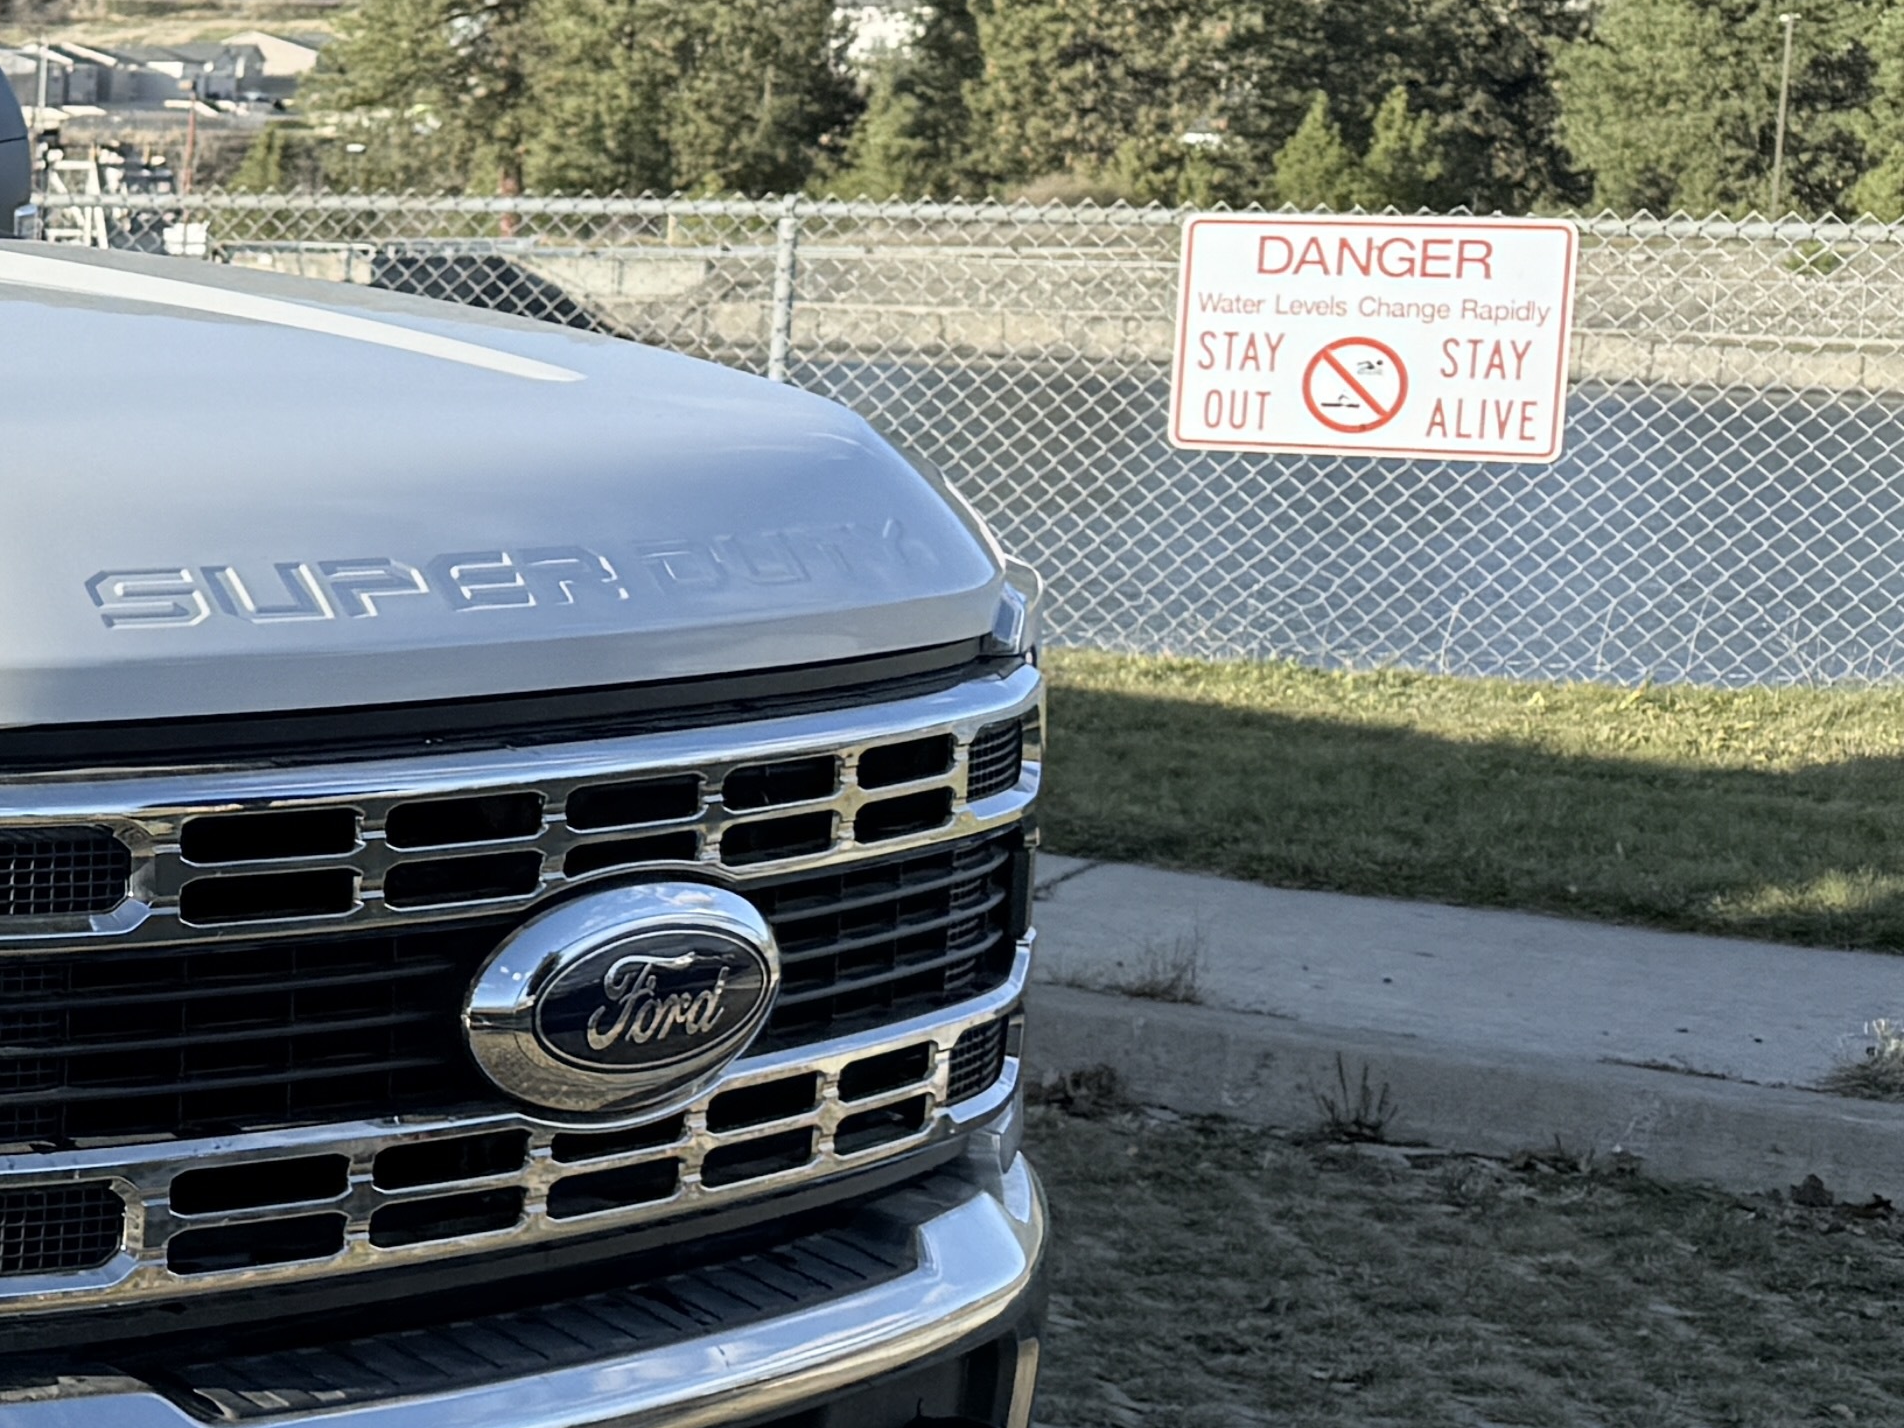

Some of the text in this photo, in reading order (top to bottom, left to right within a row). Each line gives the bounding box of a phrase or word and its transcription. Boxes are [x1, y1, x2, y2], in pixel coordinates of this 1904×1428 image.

[1256, 235, 1493, 279] DANGER
[1197, 291, 1551, 327] Water Levels Change Rapidly
[1197, 330, 1286, 373] STAY
[1439, 338, 1533, 381] STAY
[1203, 389, 1272, 431] OUT
[1425, 398, 1539, 441] ALIVE
[84, 517, 934, 629] SUPER DUTY
[586, 952, 736, 1051] Ford
